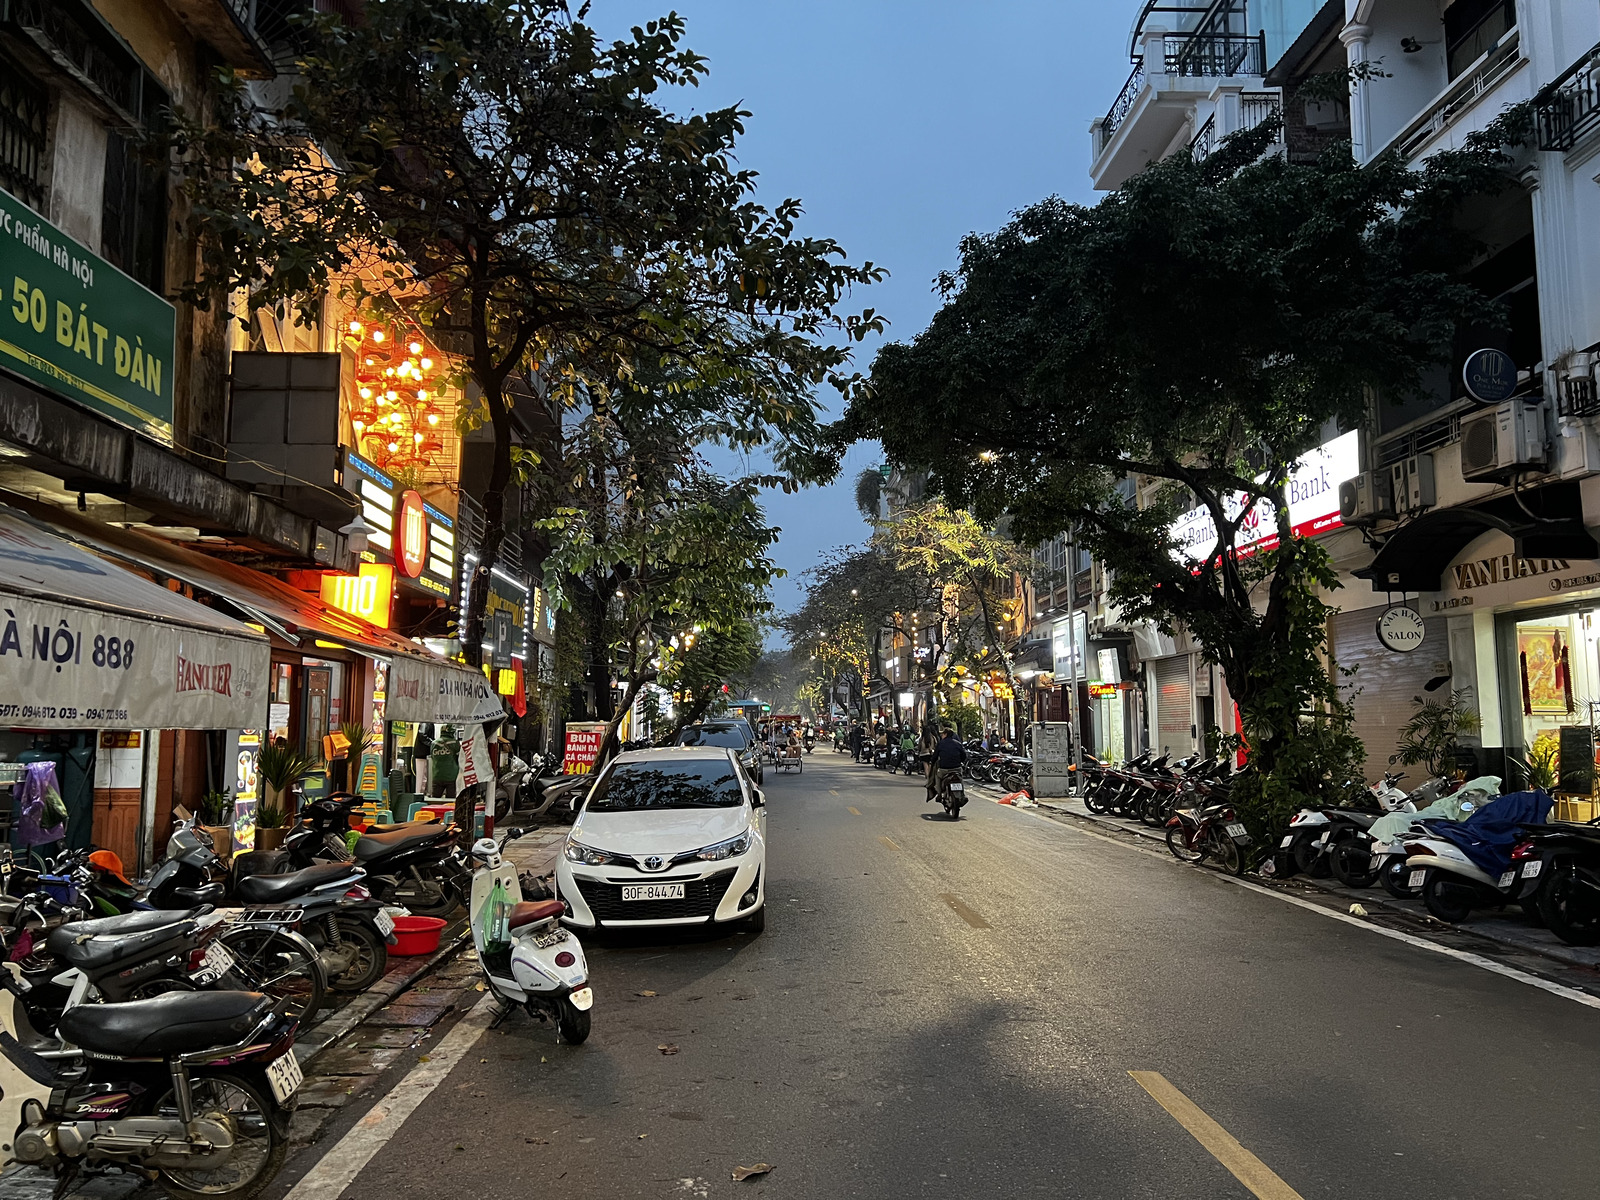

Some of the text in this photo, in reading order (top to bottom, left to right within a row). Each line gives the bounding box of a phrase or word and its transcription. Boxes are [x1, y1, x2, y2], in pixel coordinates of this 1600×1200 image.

[15, 223, 50, 260] PHẨM
[53, 244, 69, 271] HÀ
[72, 256, 93, 289] NỘI
[12, 275, 47, 333] 50
[56, 300, 108, 366] BÁT
[114, 334, 162, 397] ĐÀN
[1383, 610, 1423, 628] VAN HAIR
[1387, 631, 1422, 640] SALON
[31, 619, 82, 673] NỘI
[92, 634, 134, 670] 888
[623, 885, 683, 900] 30F-844.74
[93, 1052, 123, 1061] HONDA
